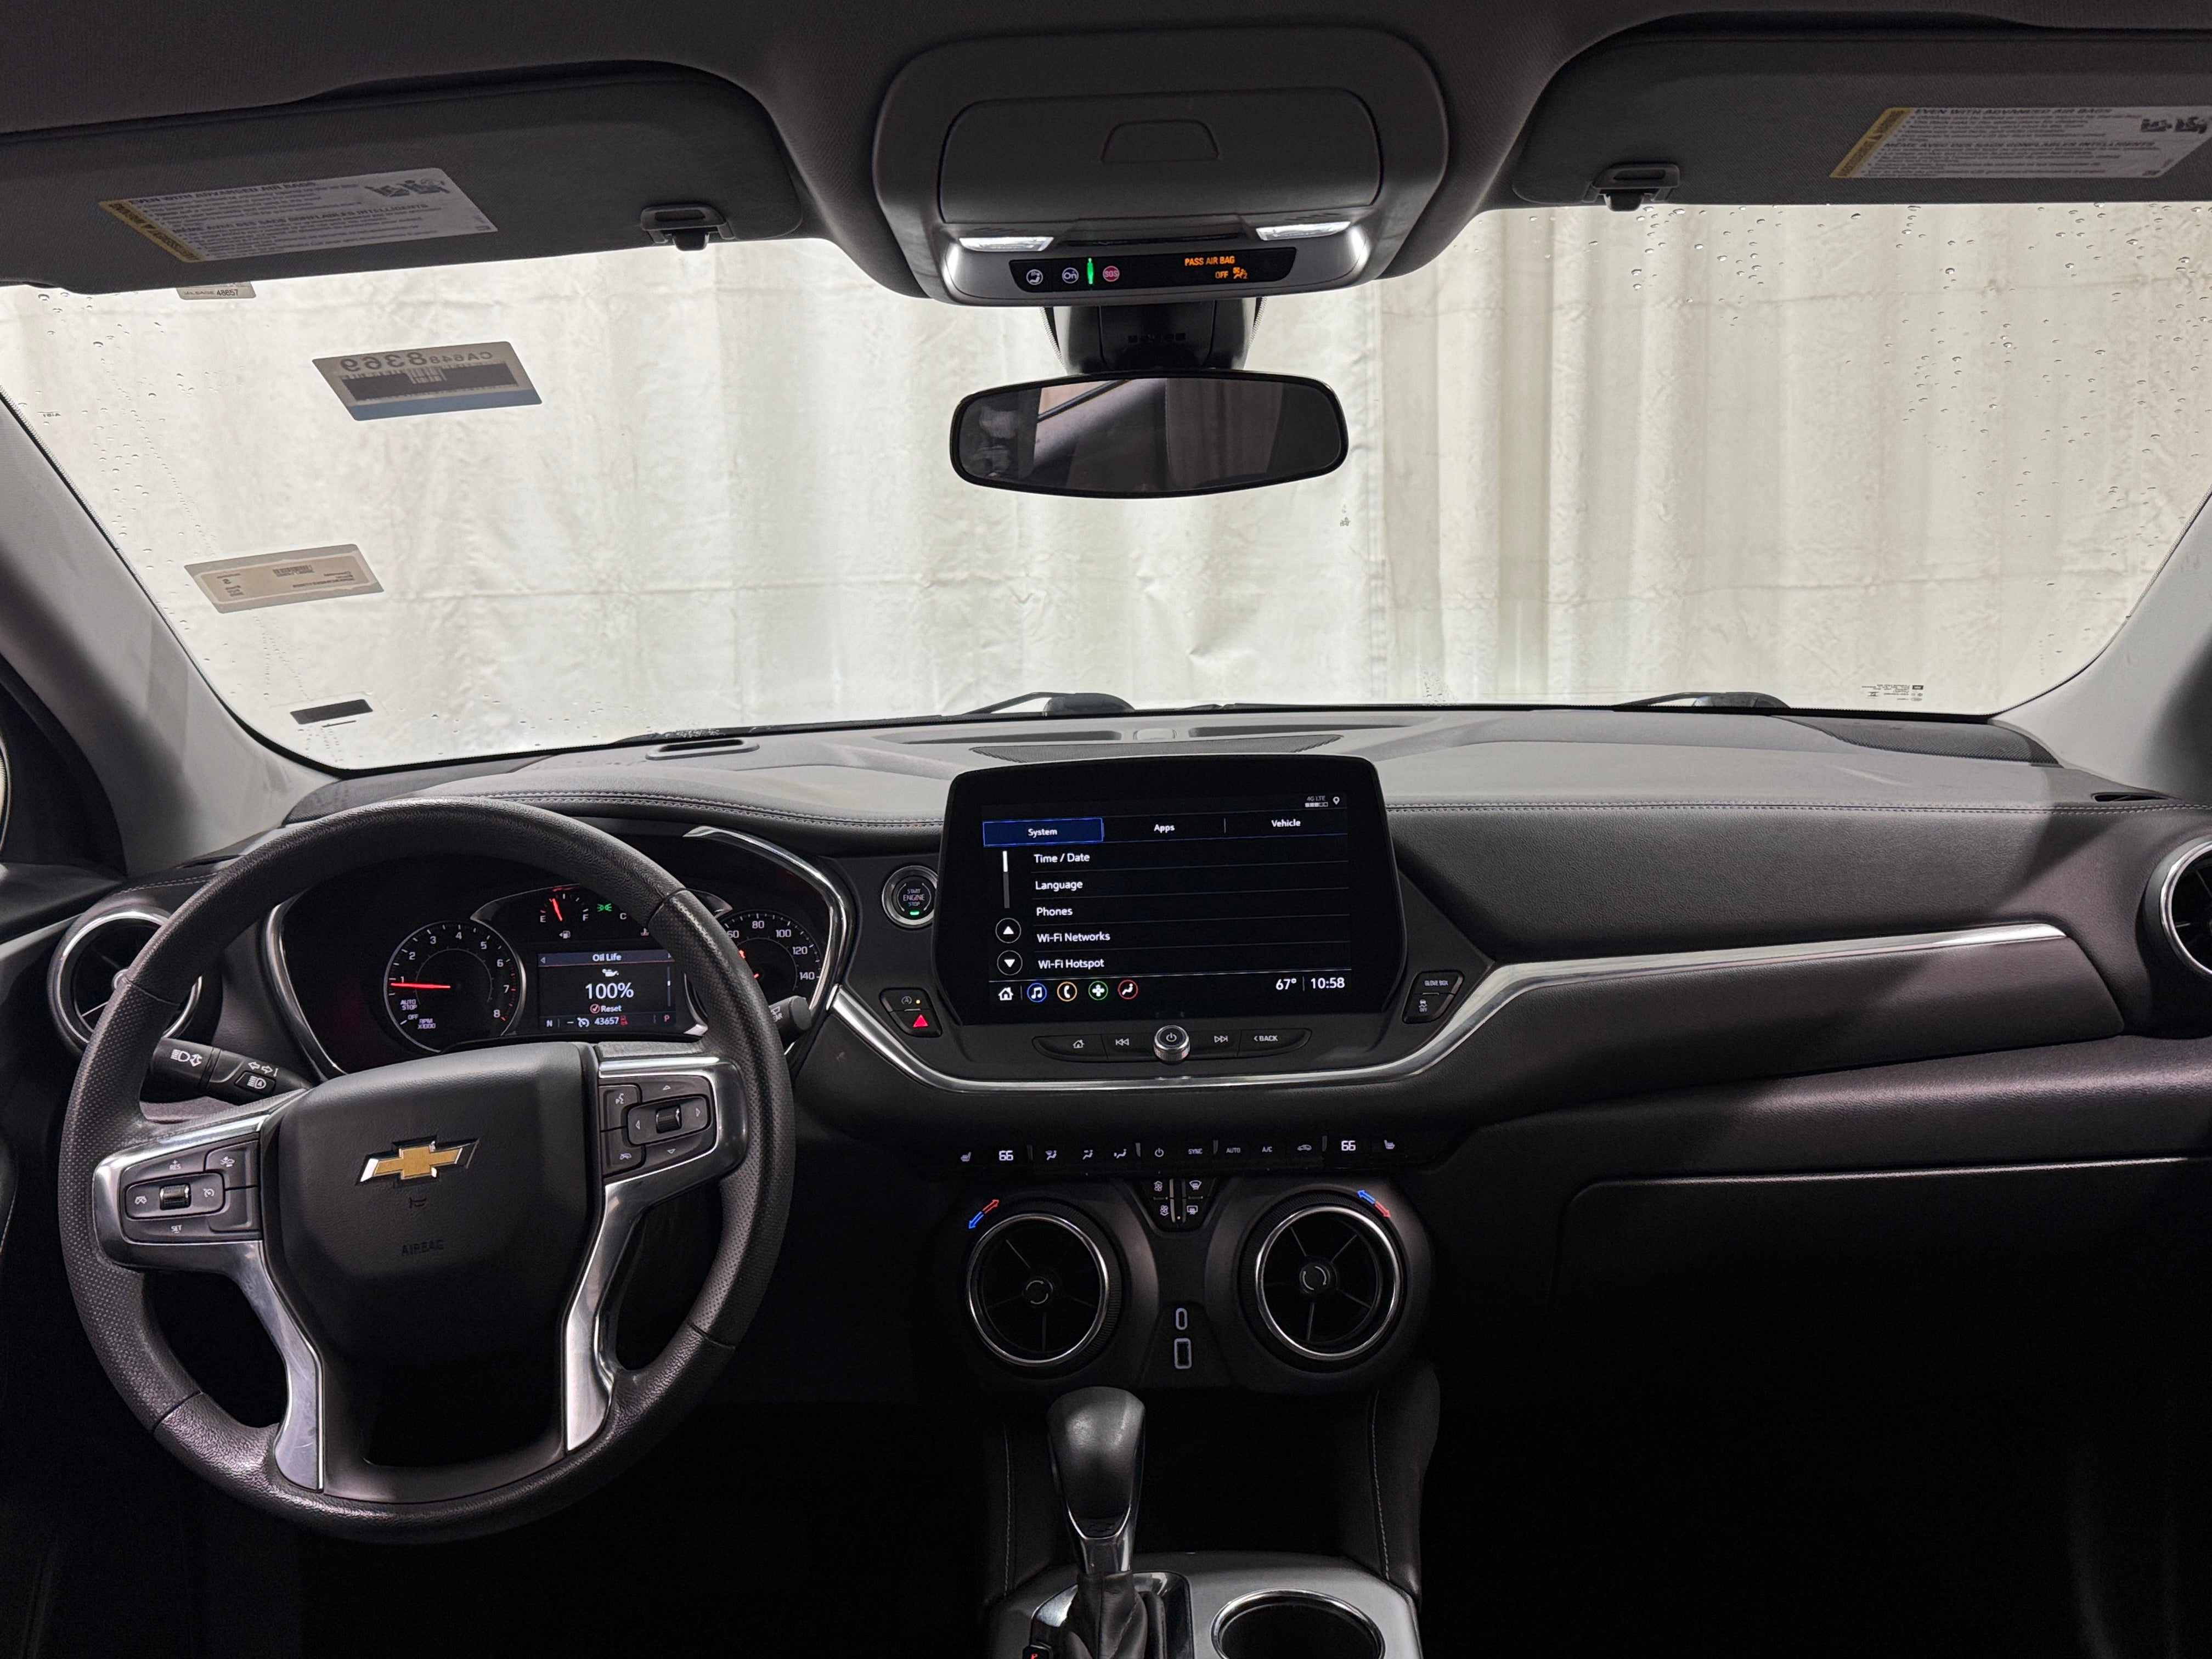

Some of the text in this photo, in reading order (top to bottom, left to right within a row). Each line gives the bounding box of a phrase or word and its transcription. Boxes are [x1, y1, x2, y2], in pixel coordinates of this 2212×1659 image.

[1184, 256, 1235, 267] PASS AIR BAG
[1215, 270, 1229, 279] OFF
[1271, 819, 1301, 827] Vehicle
[1028, 828, 1058, 838] System
[1154, 824, 1175, 833] Apps
[1034, 853, 1090, 864] Time / Date
[1035, 881, 1083, 892] Language
[1036, 907, 1073, 916] Phones
[752, 920, 765, 929] 80
[455, 932, 462, 940] 4
[726, 930, 740, 939] 60
[775, 929, 792, 938] 100
[1036, 931, 1111, 943] Wi-Fi Networks
[430, 935, 437, 945] 3
[480, 941, 487, 950] 5
[792, 946, 808, 955] 120
[409, 951, 415, 960] 2
[592, 953, 622, 962] Oil Life
[496, 959, 504, 967] 6
[1038, 958, 1105, 970] Wi-Fi Hotspot
[799, 971, 815, 980] 140
[1276, 978, 1297, 991] 67°
[1310, 977, 1345, 989] 10:58
[503, 985, 510, 994] 7
[585, 981, 635, 1000] 100%
[493, 1009, 501, 1018] 8
[601, 1005, 622, 1013] Reset
[594, 1016, 619, 1025] 43657
[1341, 1140, 1356, 1152] 66
[998, 1150, 1014, 1161] 66
